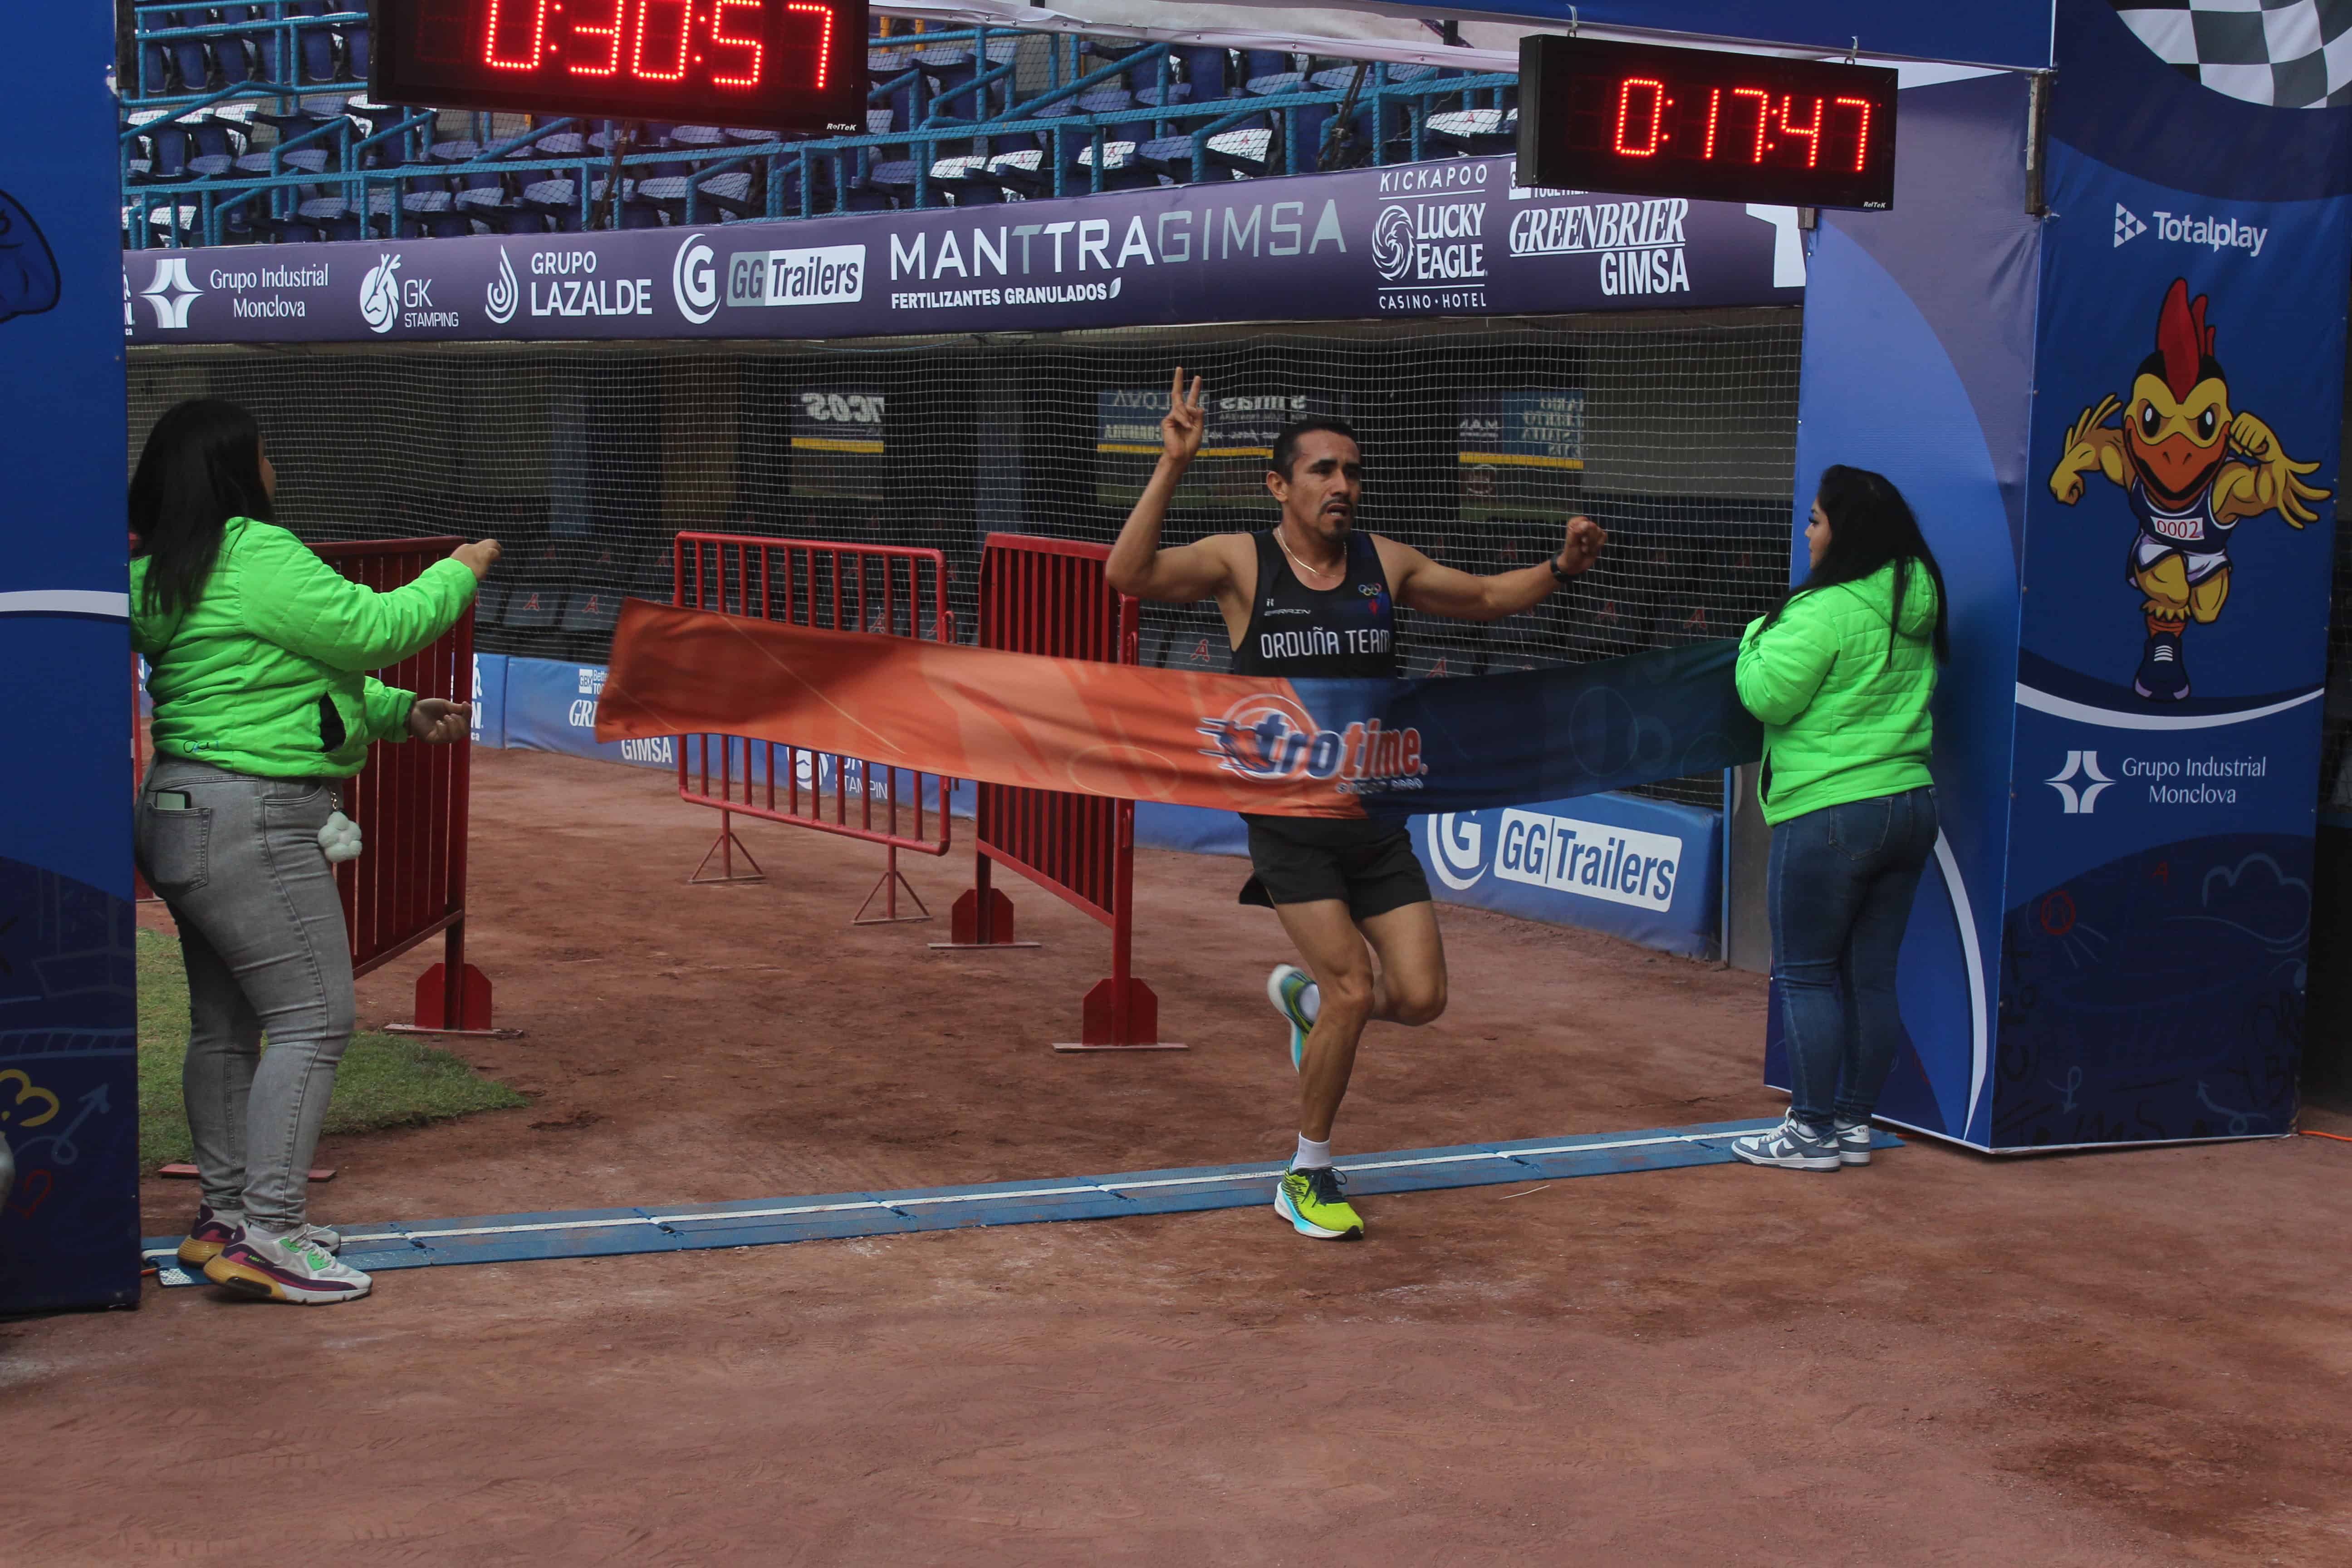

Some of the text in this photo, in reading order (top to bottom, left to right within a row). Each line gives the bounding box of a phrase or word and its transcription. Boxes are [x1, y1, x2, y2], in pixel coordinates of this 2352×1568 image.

[485, 0, 834, 89] 0:30:57
[1615, 77, 1872, 172] 0:17:47
[1380, 164, 1487, 192] KICKAPOO
[1416, 203, 1486, 240] LUCKY
[1509, 198, 1689, 254] GREENBRIER
[2152, 211, 2268, 257] Totalplay
[531, 250, 597, 274] GRUPO
[1416, 243, 1485, 279] EAGLE
[1600, 248, 1690, 296] GIMSA
[210, 263, 329, 294] Grupo Industrial
[234, 294, 306, 318] Monclova
[404, 279, 433, 308] GK
[531, 279, 652, 316] LAZALDE
[891, 283, 1107, 309] FERTILIZANTES GRANULADOS
[1379, 293, 1487, 309] CASINO HOTEL
[404, 312, 459, 328] STAMPING
[2157, 520, 2200, 539] 0002
[1261, 626, 1391, 658] ORDUÑA TEAM
[621, 736, 673, 763] GIMSA
[2122, 756, 2267, 781] Grupo Industrial
[2149, 783, 2236, 804] Monclova
